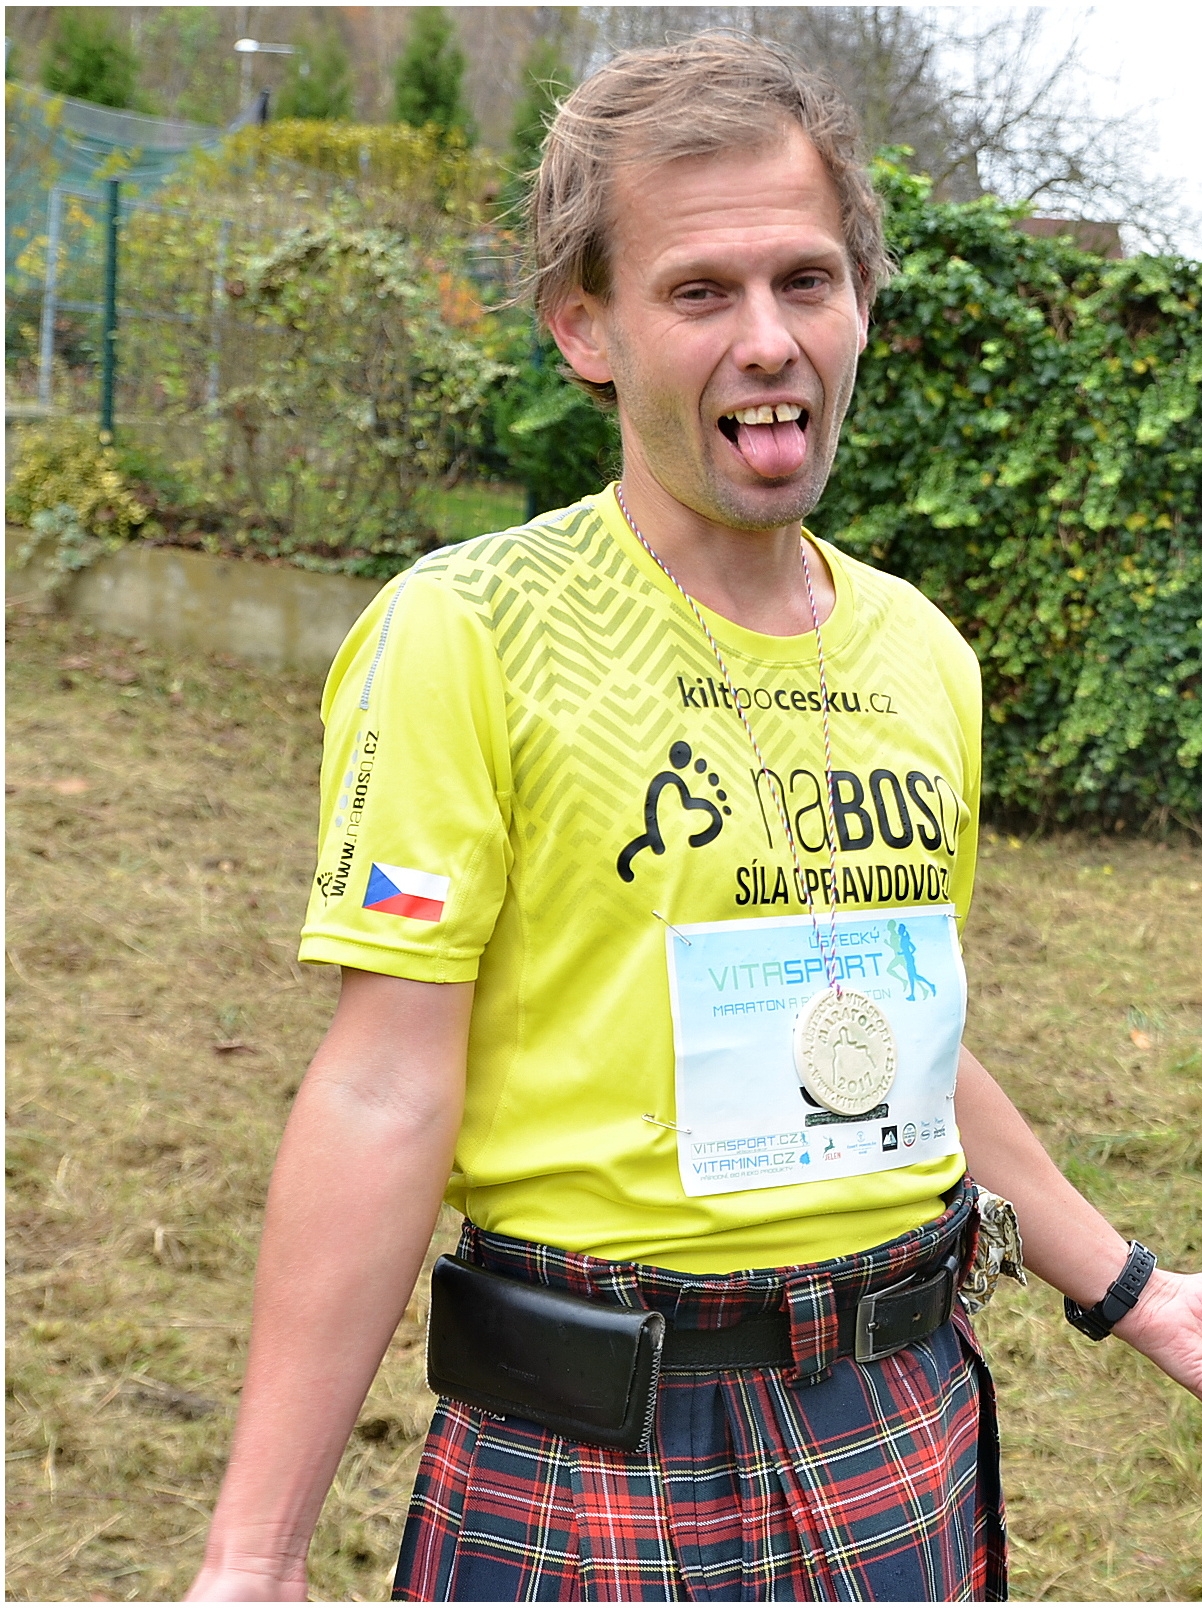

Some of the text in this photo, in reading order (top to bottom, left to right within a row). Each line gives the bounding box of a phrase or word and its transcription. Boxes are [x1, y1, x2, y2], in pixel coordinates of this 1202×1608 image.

[677, 676, 898, 718] kiltpocesku.cz
[735, 858, 789, 905] SÍLA
[708, 953, 883, 992] VITASPORT
[712, 999, 786, 1018] MARATON
[818, 1007, 877, 1045] MARATON
[837, 1071, 873, 1093] 2017
[693, 1133, 798, 1154] VITASPORT.CZ
[692, 1152, 796, 1174] VITAMINA.CZ
[824, 1152, 842, 1161] JELEN
